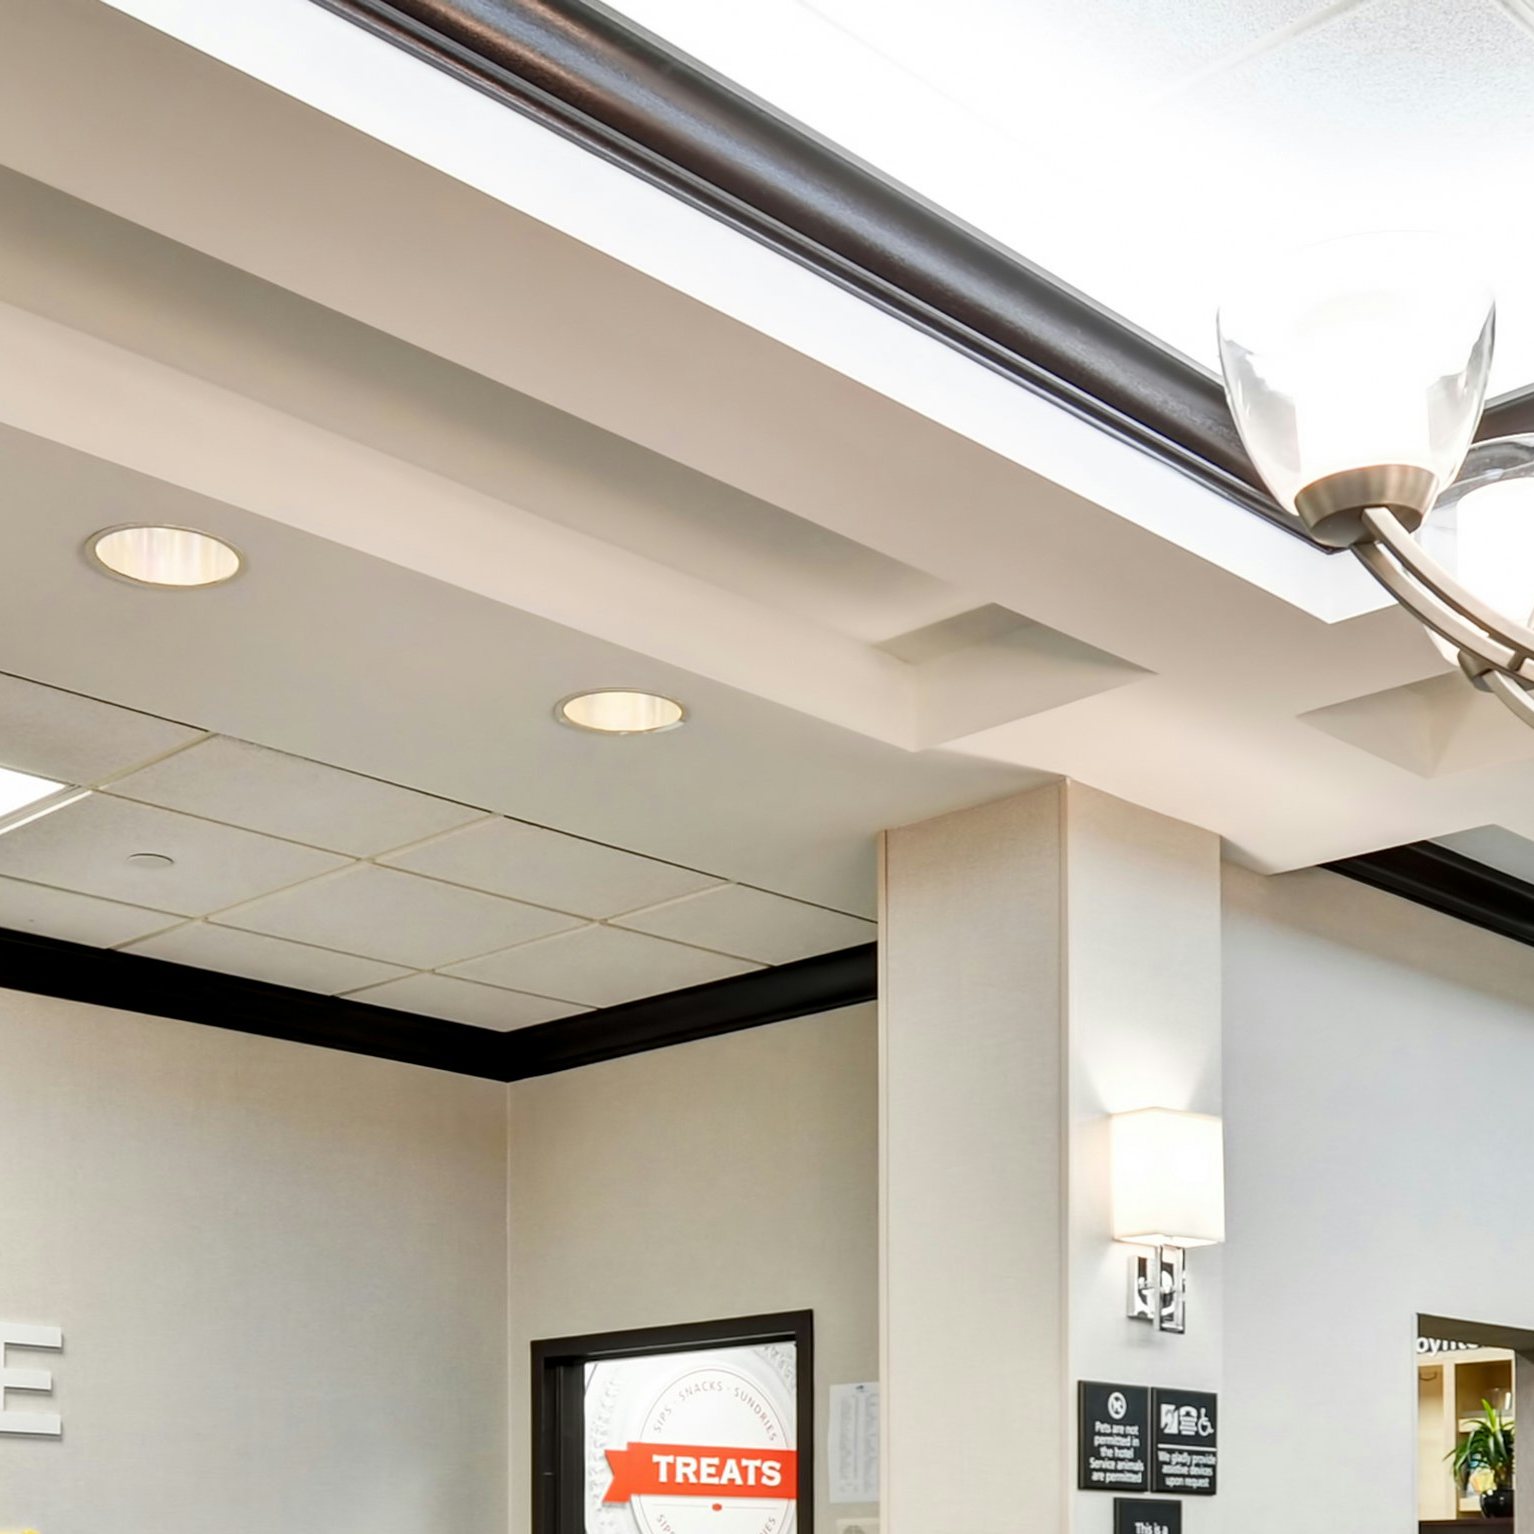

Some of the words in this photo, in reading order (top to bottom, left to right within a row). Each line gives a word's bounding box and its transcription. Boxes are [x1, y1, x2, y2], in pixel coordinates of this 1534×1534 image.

[653, 1406, 673, 1434] SIPS
[678, 1380, 724, 1402] SNACKS
[734, 1386, 778, 1442] SUNDRIES
[1099, 1446, 1114, 1458] the
[651, 1454, 783, 1488] TREATS
